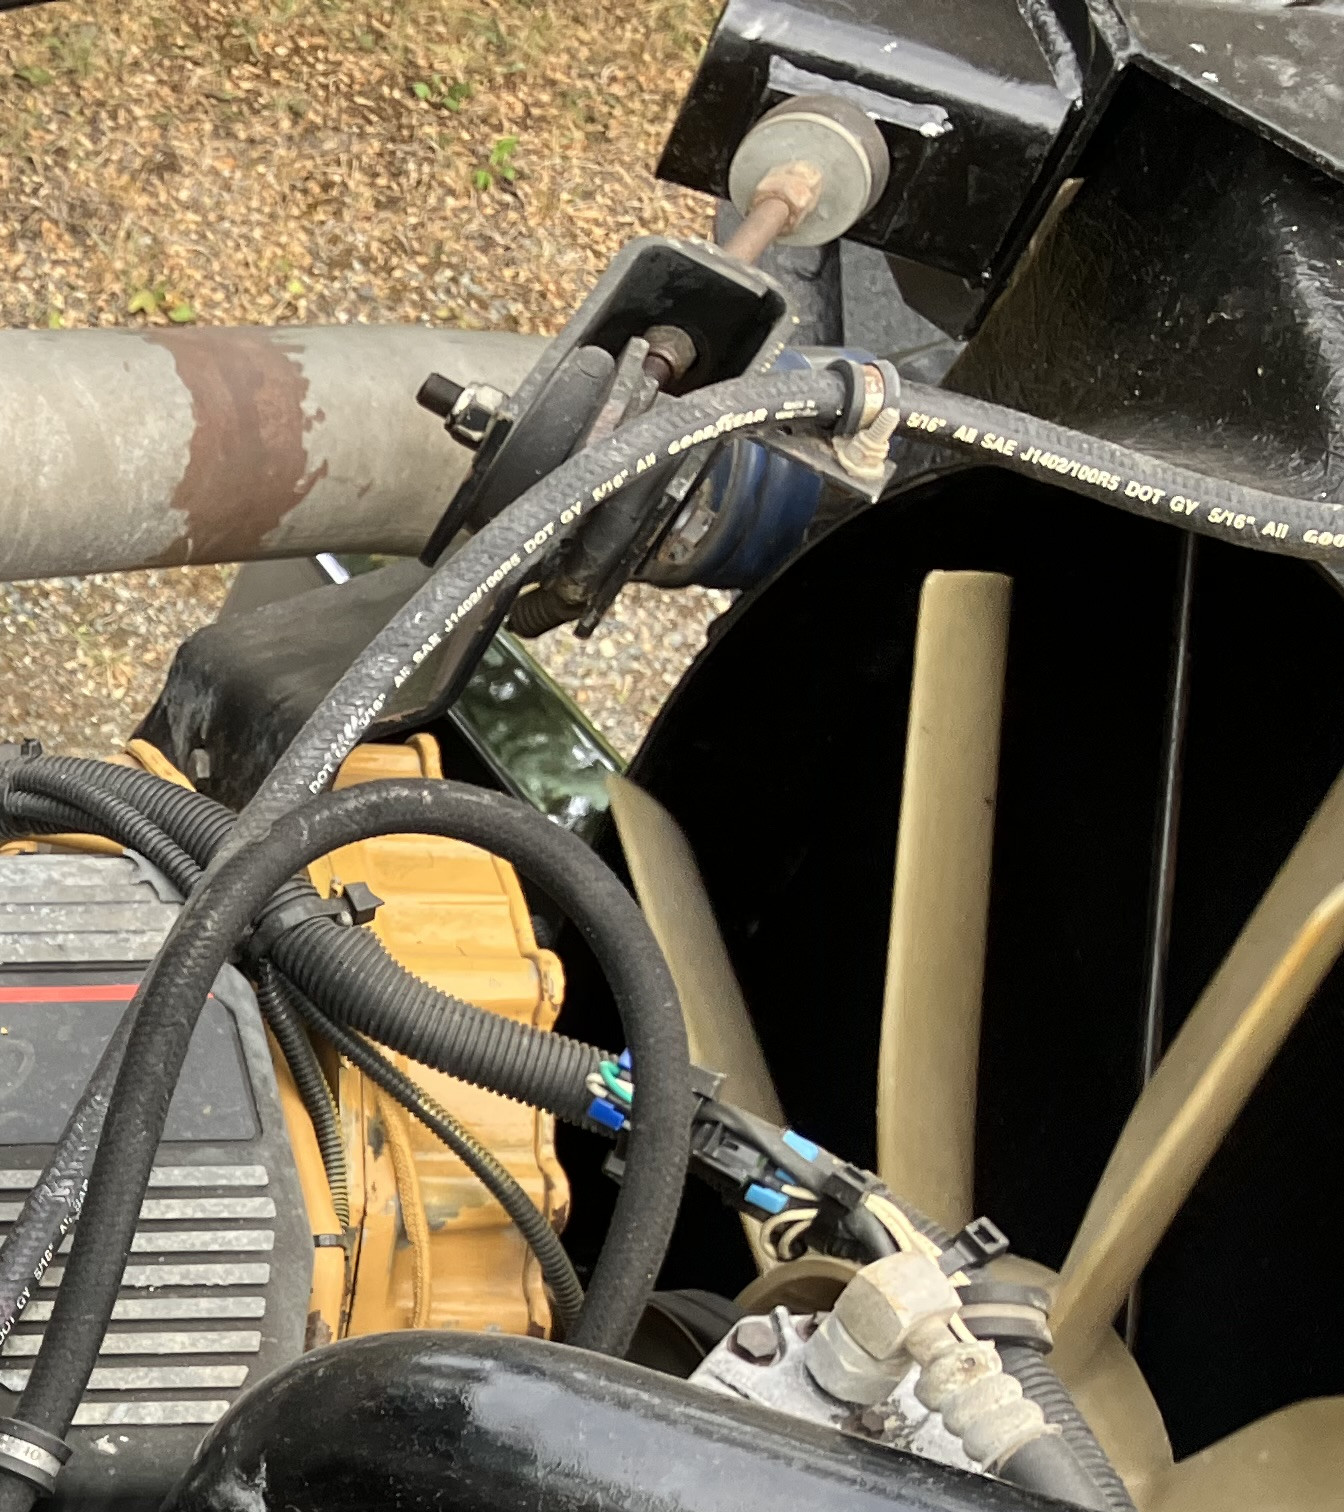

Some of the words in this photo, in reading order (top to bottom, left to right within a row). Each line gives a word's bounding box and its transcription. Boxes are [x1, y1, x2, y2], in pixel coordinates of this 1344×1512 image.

[906, 411, 947, 433] 5/16"
[980, 432, 1018, 457] SAE
[1019, 446, 1121, 492] J1402/100R5
[1124, 480, 1166, 505] DOT
[1169, 495, 1200, 516] GY
[1207, 507, 1256, 530] 5/16"
[309, 762, 334, 794] DOT
[412, 631, 442, 668] SAE
[523, 520, 557, 554] DOT
[560, 500, 583, 525] GY
[16, 1286, 32, 1311] GY
